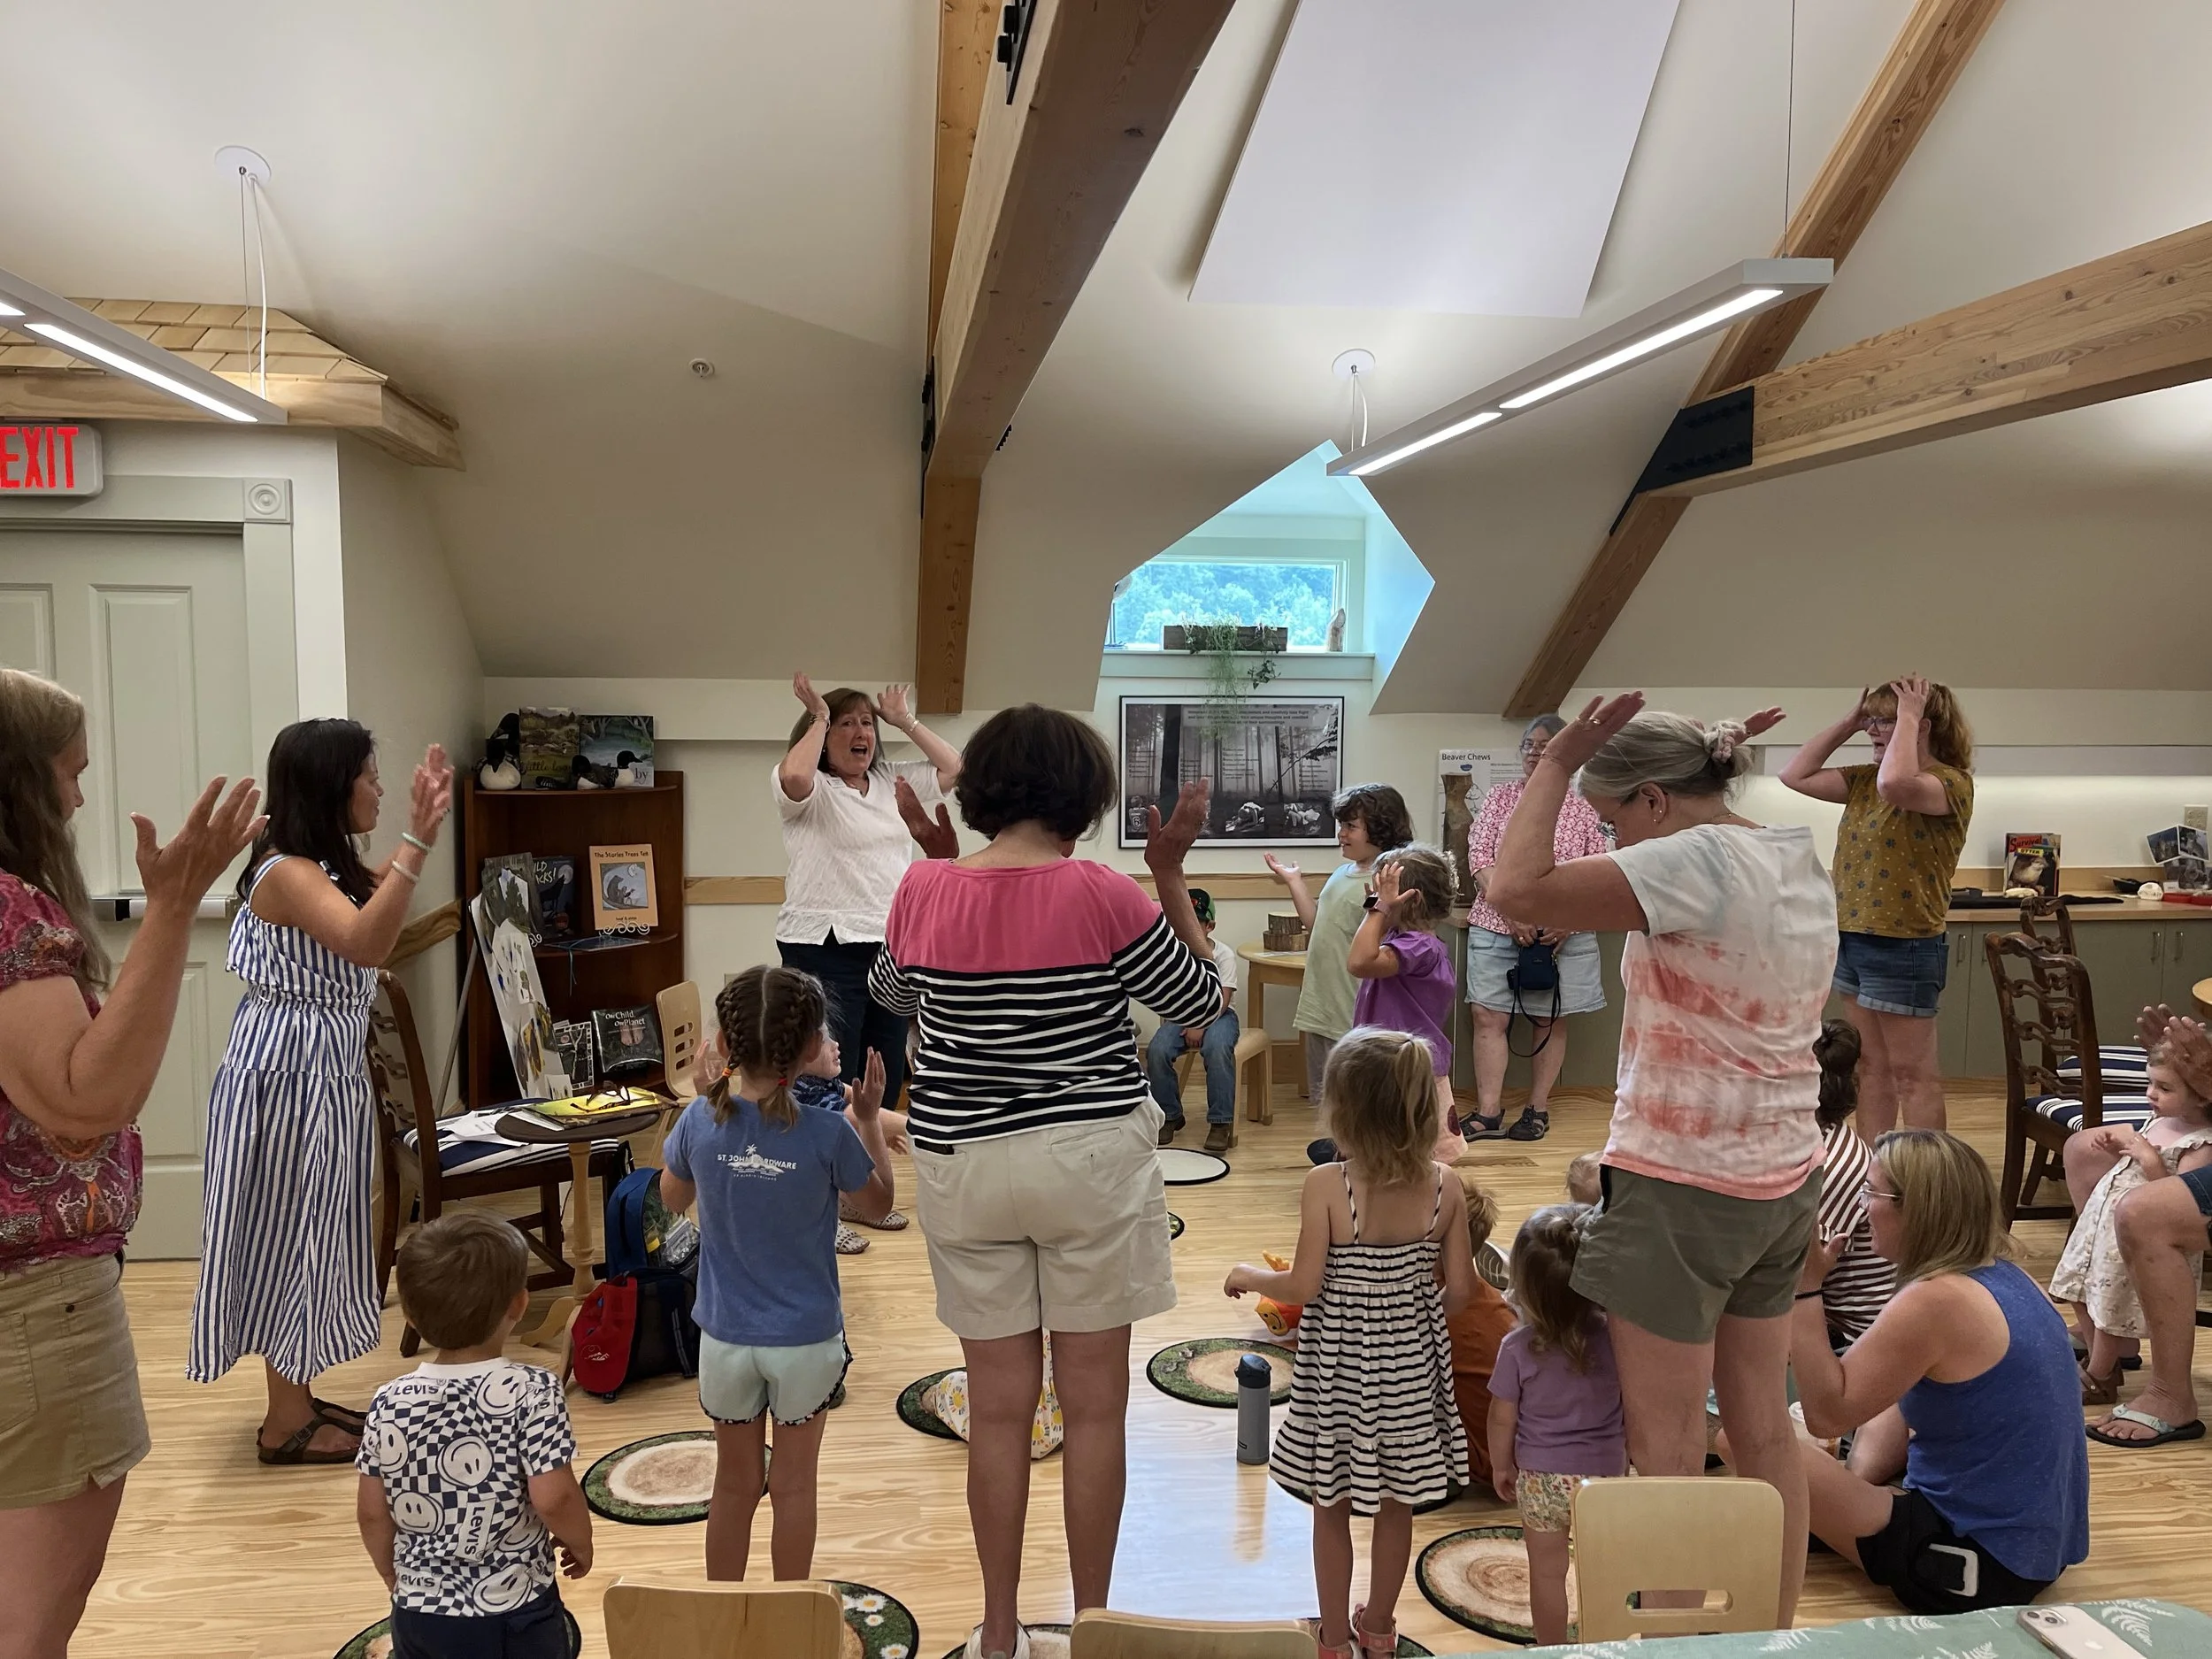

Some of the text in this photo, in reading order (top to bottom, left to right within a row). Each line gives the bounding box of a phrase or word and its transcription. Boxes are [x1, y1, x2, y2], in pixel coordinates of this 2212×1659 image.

[0, 426, 78, 488] EXIT
[2009, 835, 2042, 852] Survival
[534, 861, 547, 872] ILD
[624, 1018, 646, 1026] Planet
[394, 1384, 440, 1395] Levi's
[465, 1506, 486, 1555] Levi's
[401, 1573, 435, 1587] evi's
